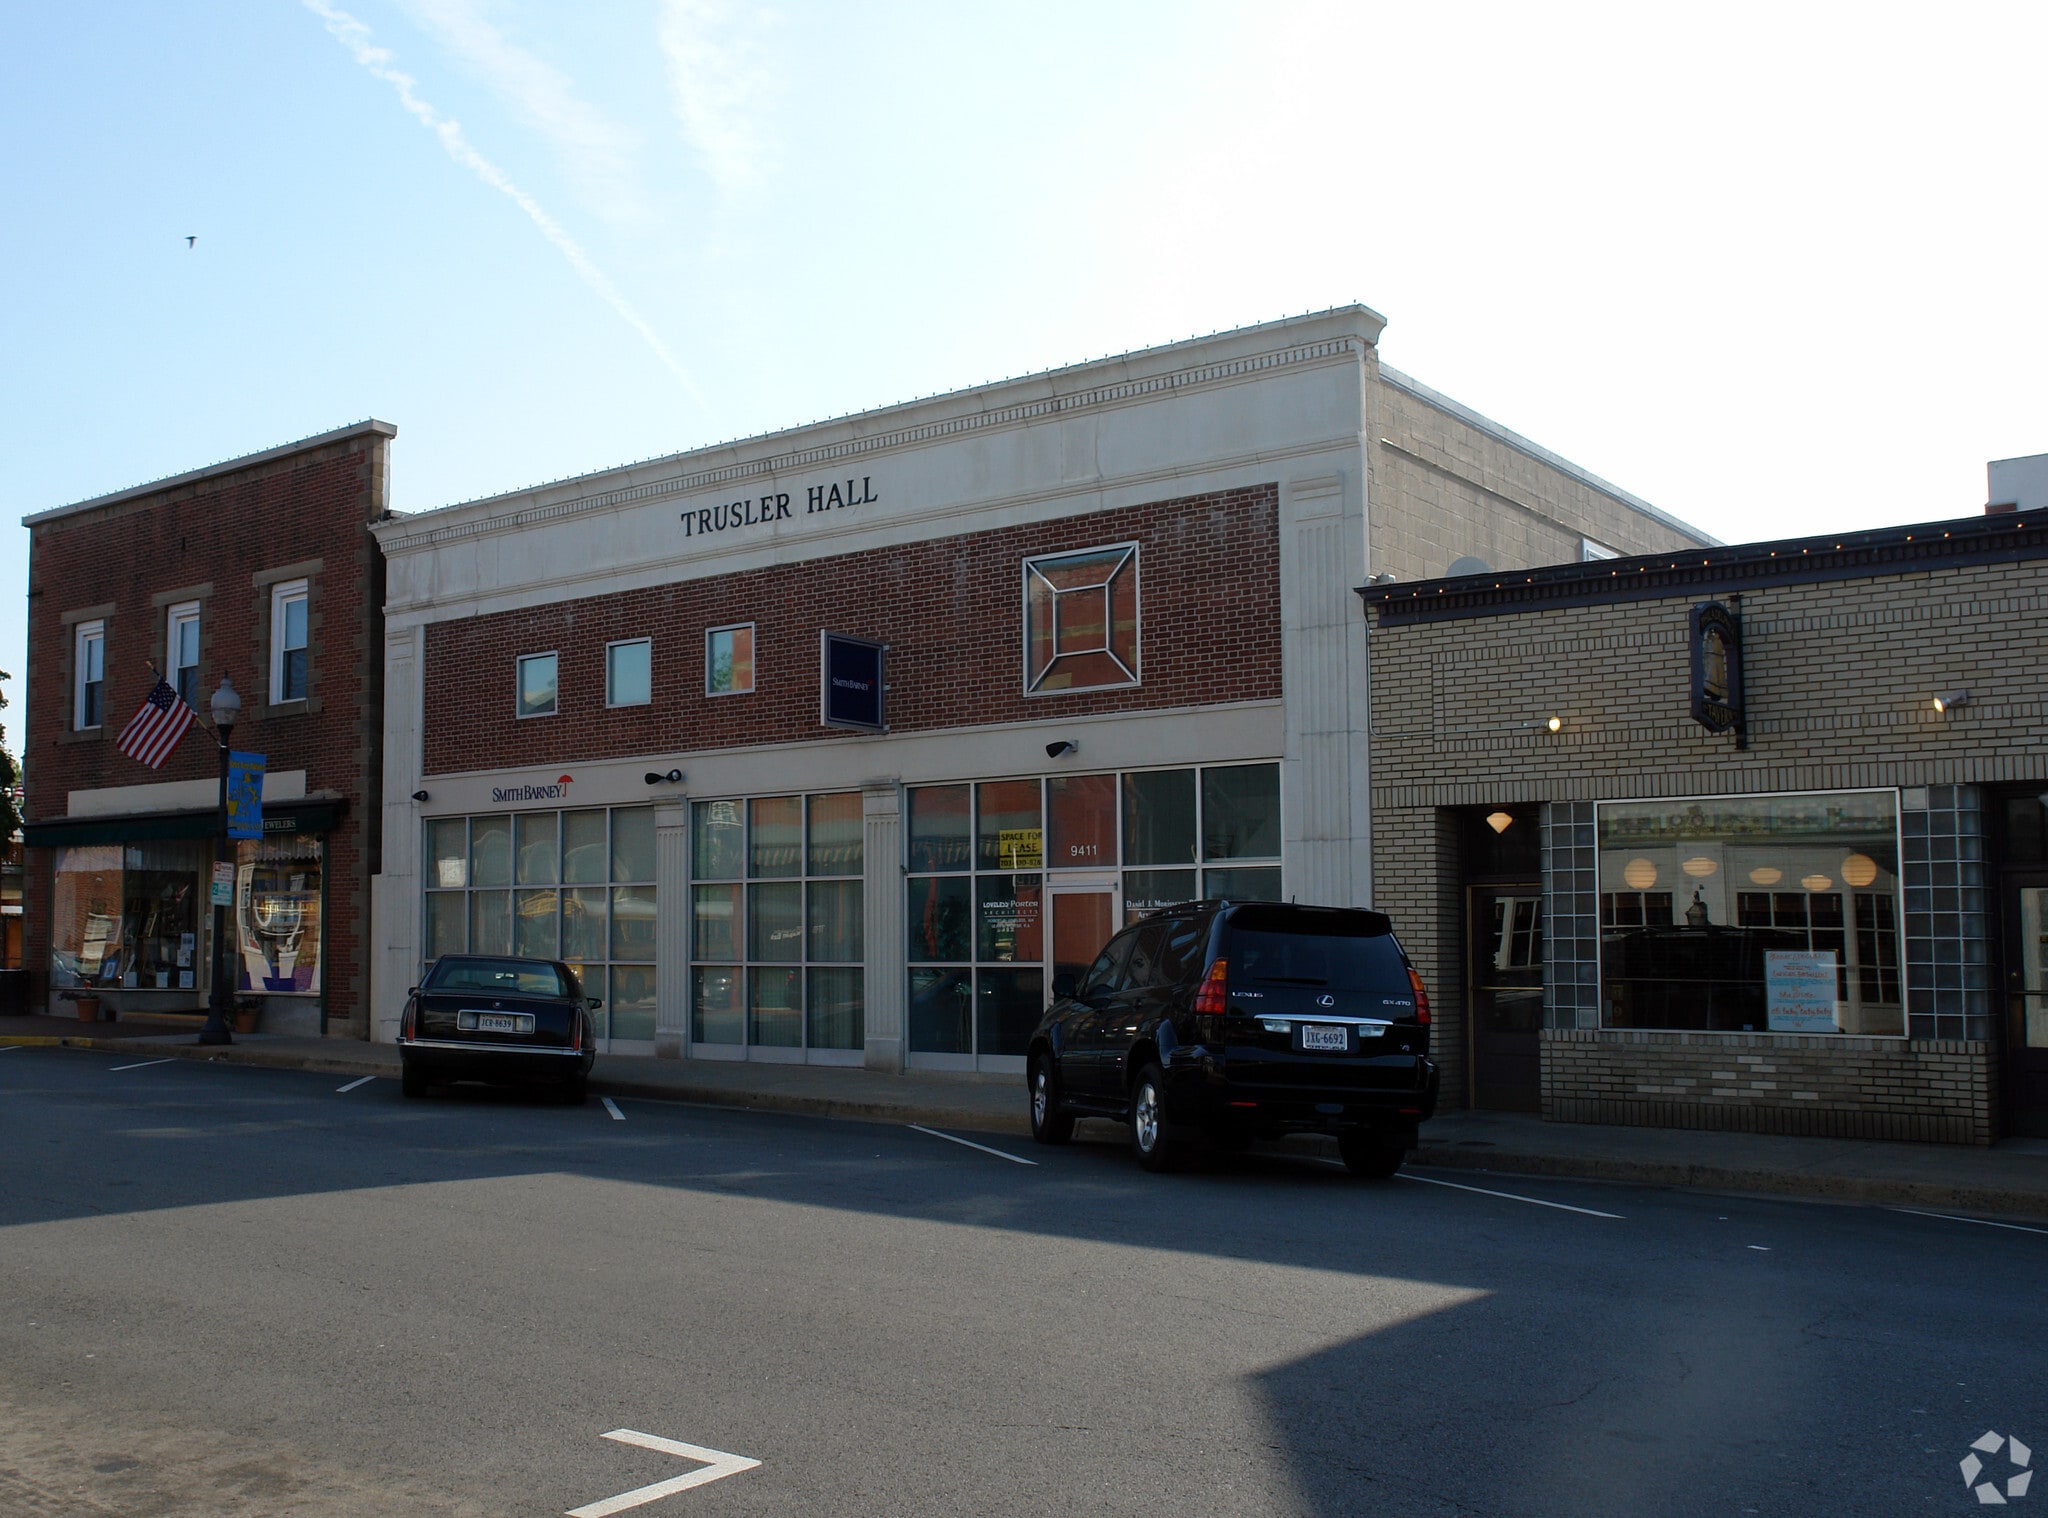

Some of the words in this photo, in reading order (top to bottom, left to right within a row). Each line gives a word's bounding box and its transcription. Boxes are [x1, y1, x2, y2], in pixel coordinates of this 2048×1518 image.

[681, 492, 793, 537] TRUSLER
[806, 476, 879, 514] HALL
[1001, 832, 1024, 841] SPACE
[1007, 842, 1037, 853] LEASE
[1070, 845, 1098, 856] 9411
[1126, 900, 1145, 908] David
